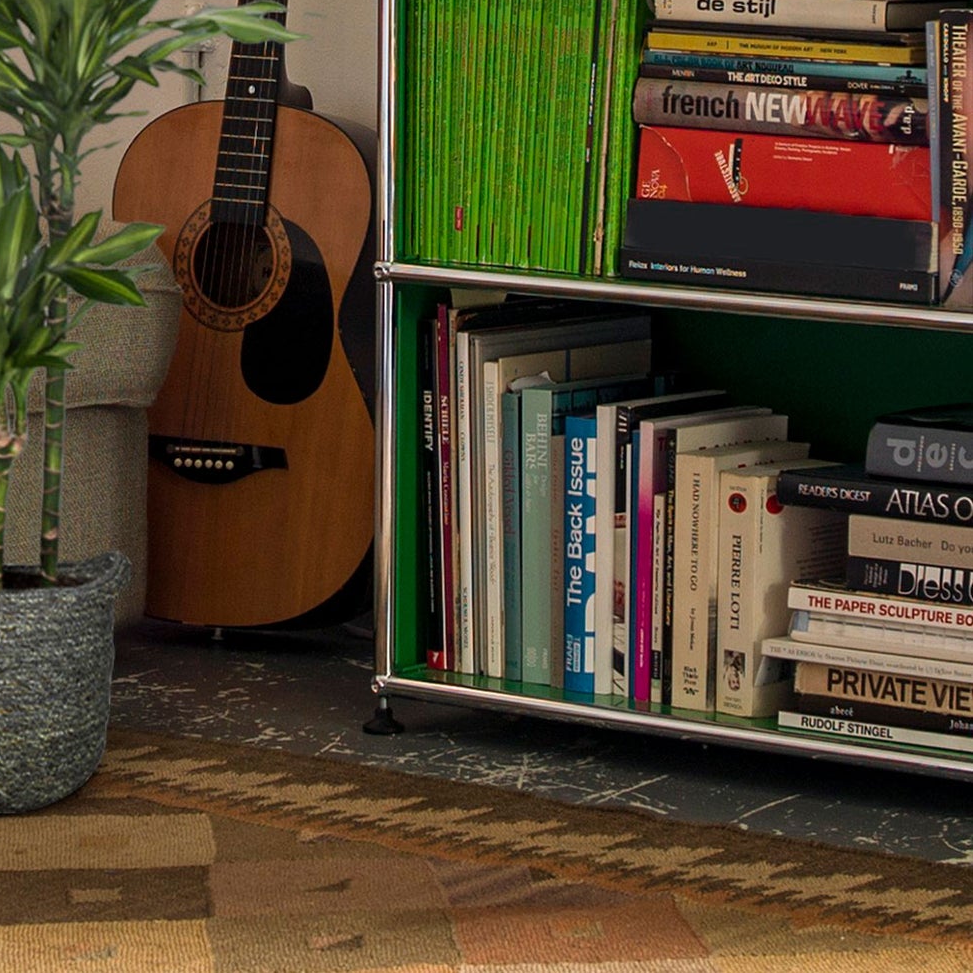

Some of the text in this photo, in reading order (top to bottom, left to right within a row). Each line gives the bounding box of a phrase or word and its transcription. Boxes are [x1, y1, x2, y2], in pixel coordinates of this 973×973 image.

[700, 57, 724, 69] BOOK
[736, 59, 752, 71] ART
[755, 61, 794, 73] NOUVEAU
[727, 71, 807, 87] THE ART DECO STYLE
[847, 81, 868, 90] DOVER
[661, 85, 886, 132] french NEW WAVE
[951, 23, 969, 254] THEATER OF THE AVANT-GARDE, 1890-1950
[641, 180, 651, 198] GE
[650, 168, 660, 198] NOVA
[628, 260, 747, 278] Relax Interiors for Human Wellness
[423, 390, 433, 451] IDENTIFY
[441, 395, 449, 445] SCHIELE
[503, 450, 515, 535] Gilded Vessel
[839, 489, 871, 503] DIGEST
[885, 488, 950, 518] ATLAS
[567, 437, 583, 607] The Back Issue
[691, 503, 699, 556] NOWHERE
[872, 533, 956, 552] Lutz Bacher Do
[691, 559, 698, 573] TO
[691, 574, 698, 591] GO
[730, 534, 742, 630] PIERRE LOTI
[898, 563, 965, 602] Dress
[808, 595, 831, 609] THE
[834, 598, 876, 616] PAPER
[878, 604, 953, 624] SCULPTURE
[827, 668, 927, 706] PRIVATE
[800, 716, 894, 739] RUDOLF STINGEL
